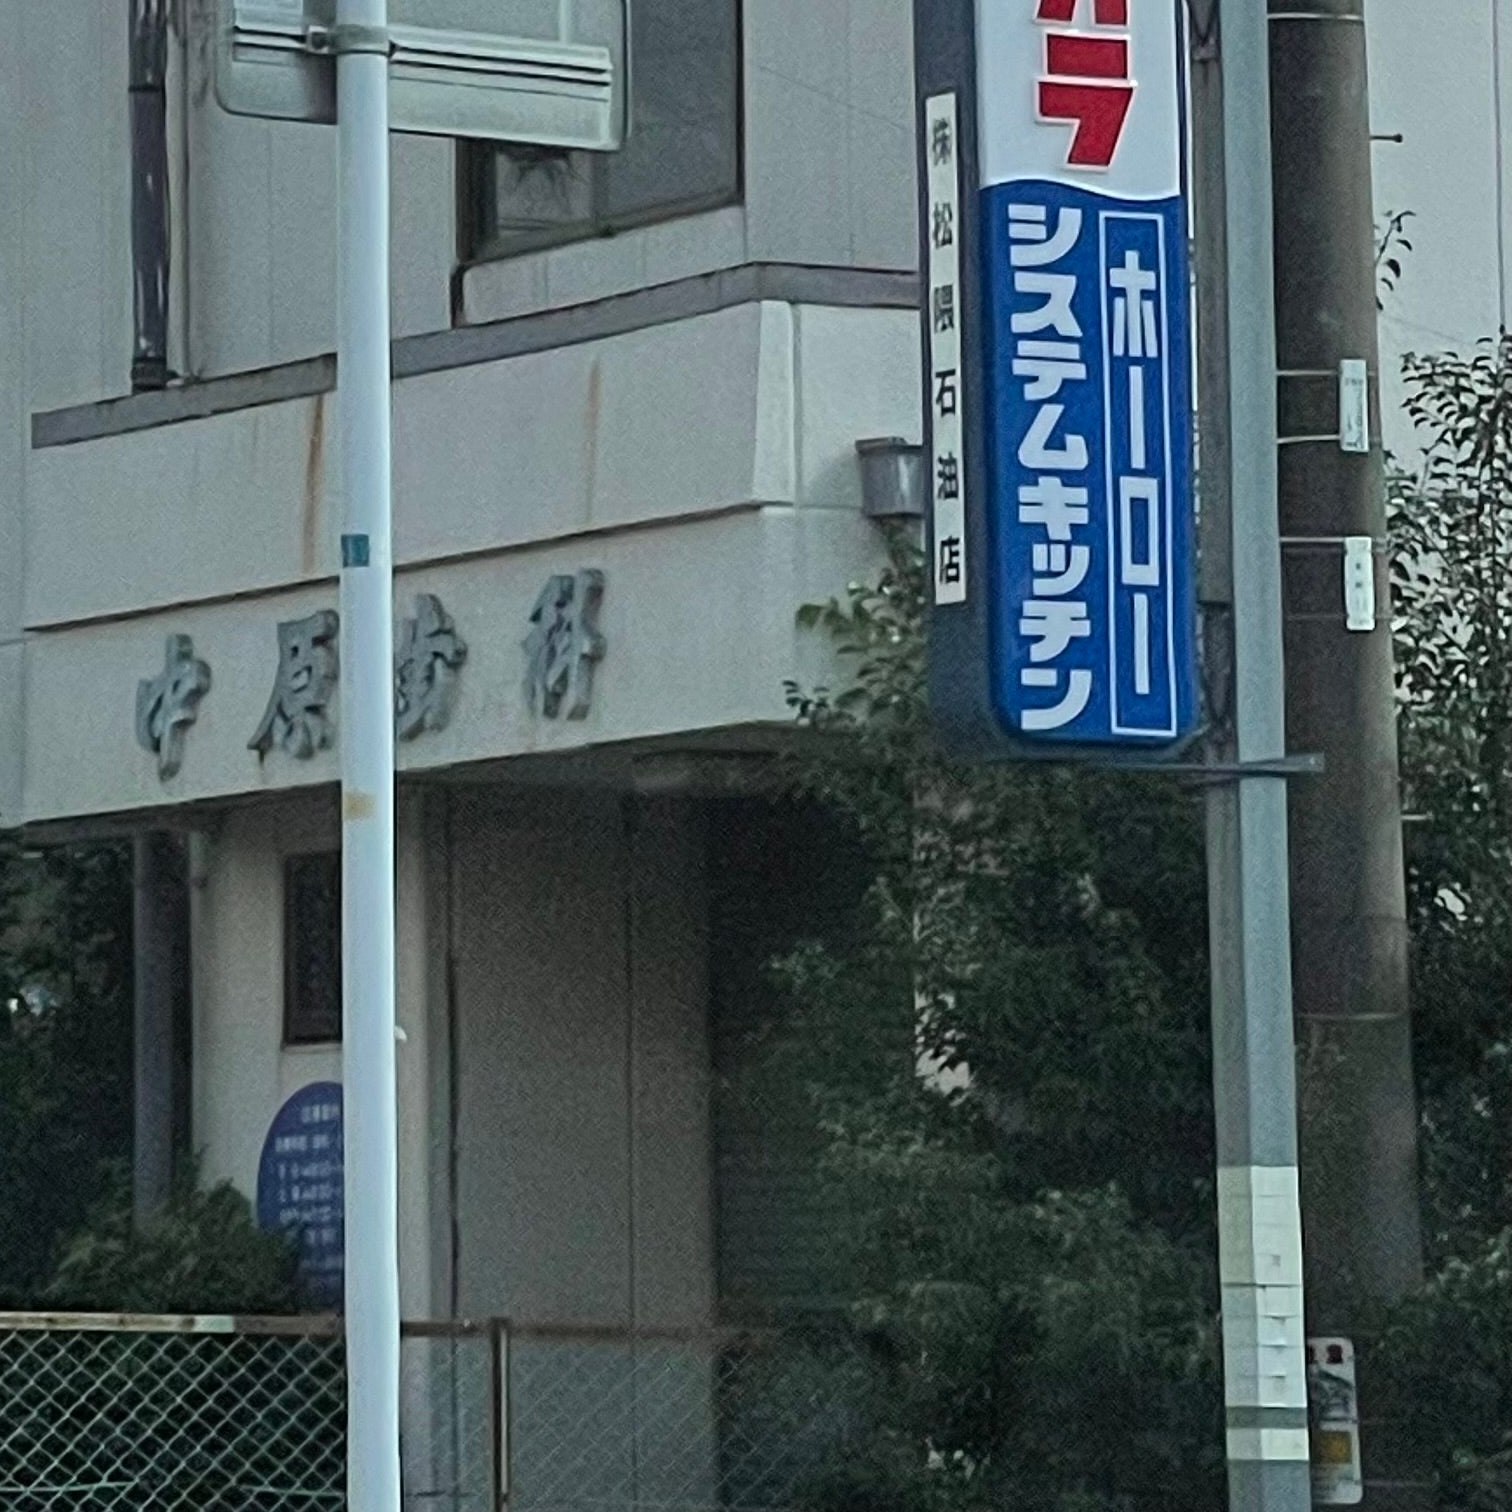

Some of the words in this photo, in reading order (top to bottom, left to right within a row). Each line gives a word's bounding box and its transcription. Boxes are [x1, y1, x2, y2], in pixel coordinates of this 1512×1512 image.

[1007, 203, 1093, 731] システムキッチン
[1109, 249, 1159, 695] ホーロー
